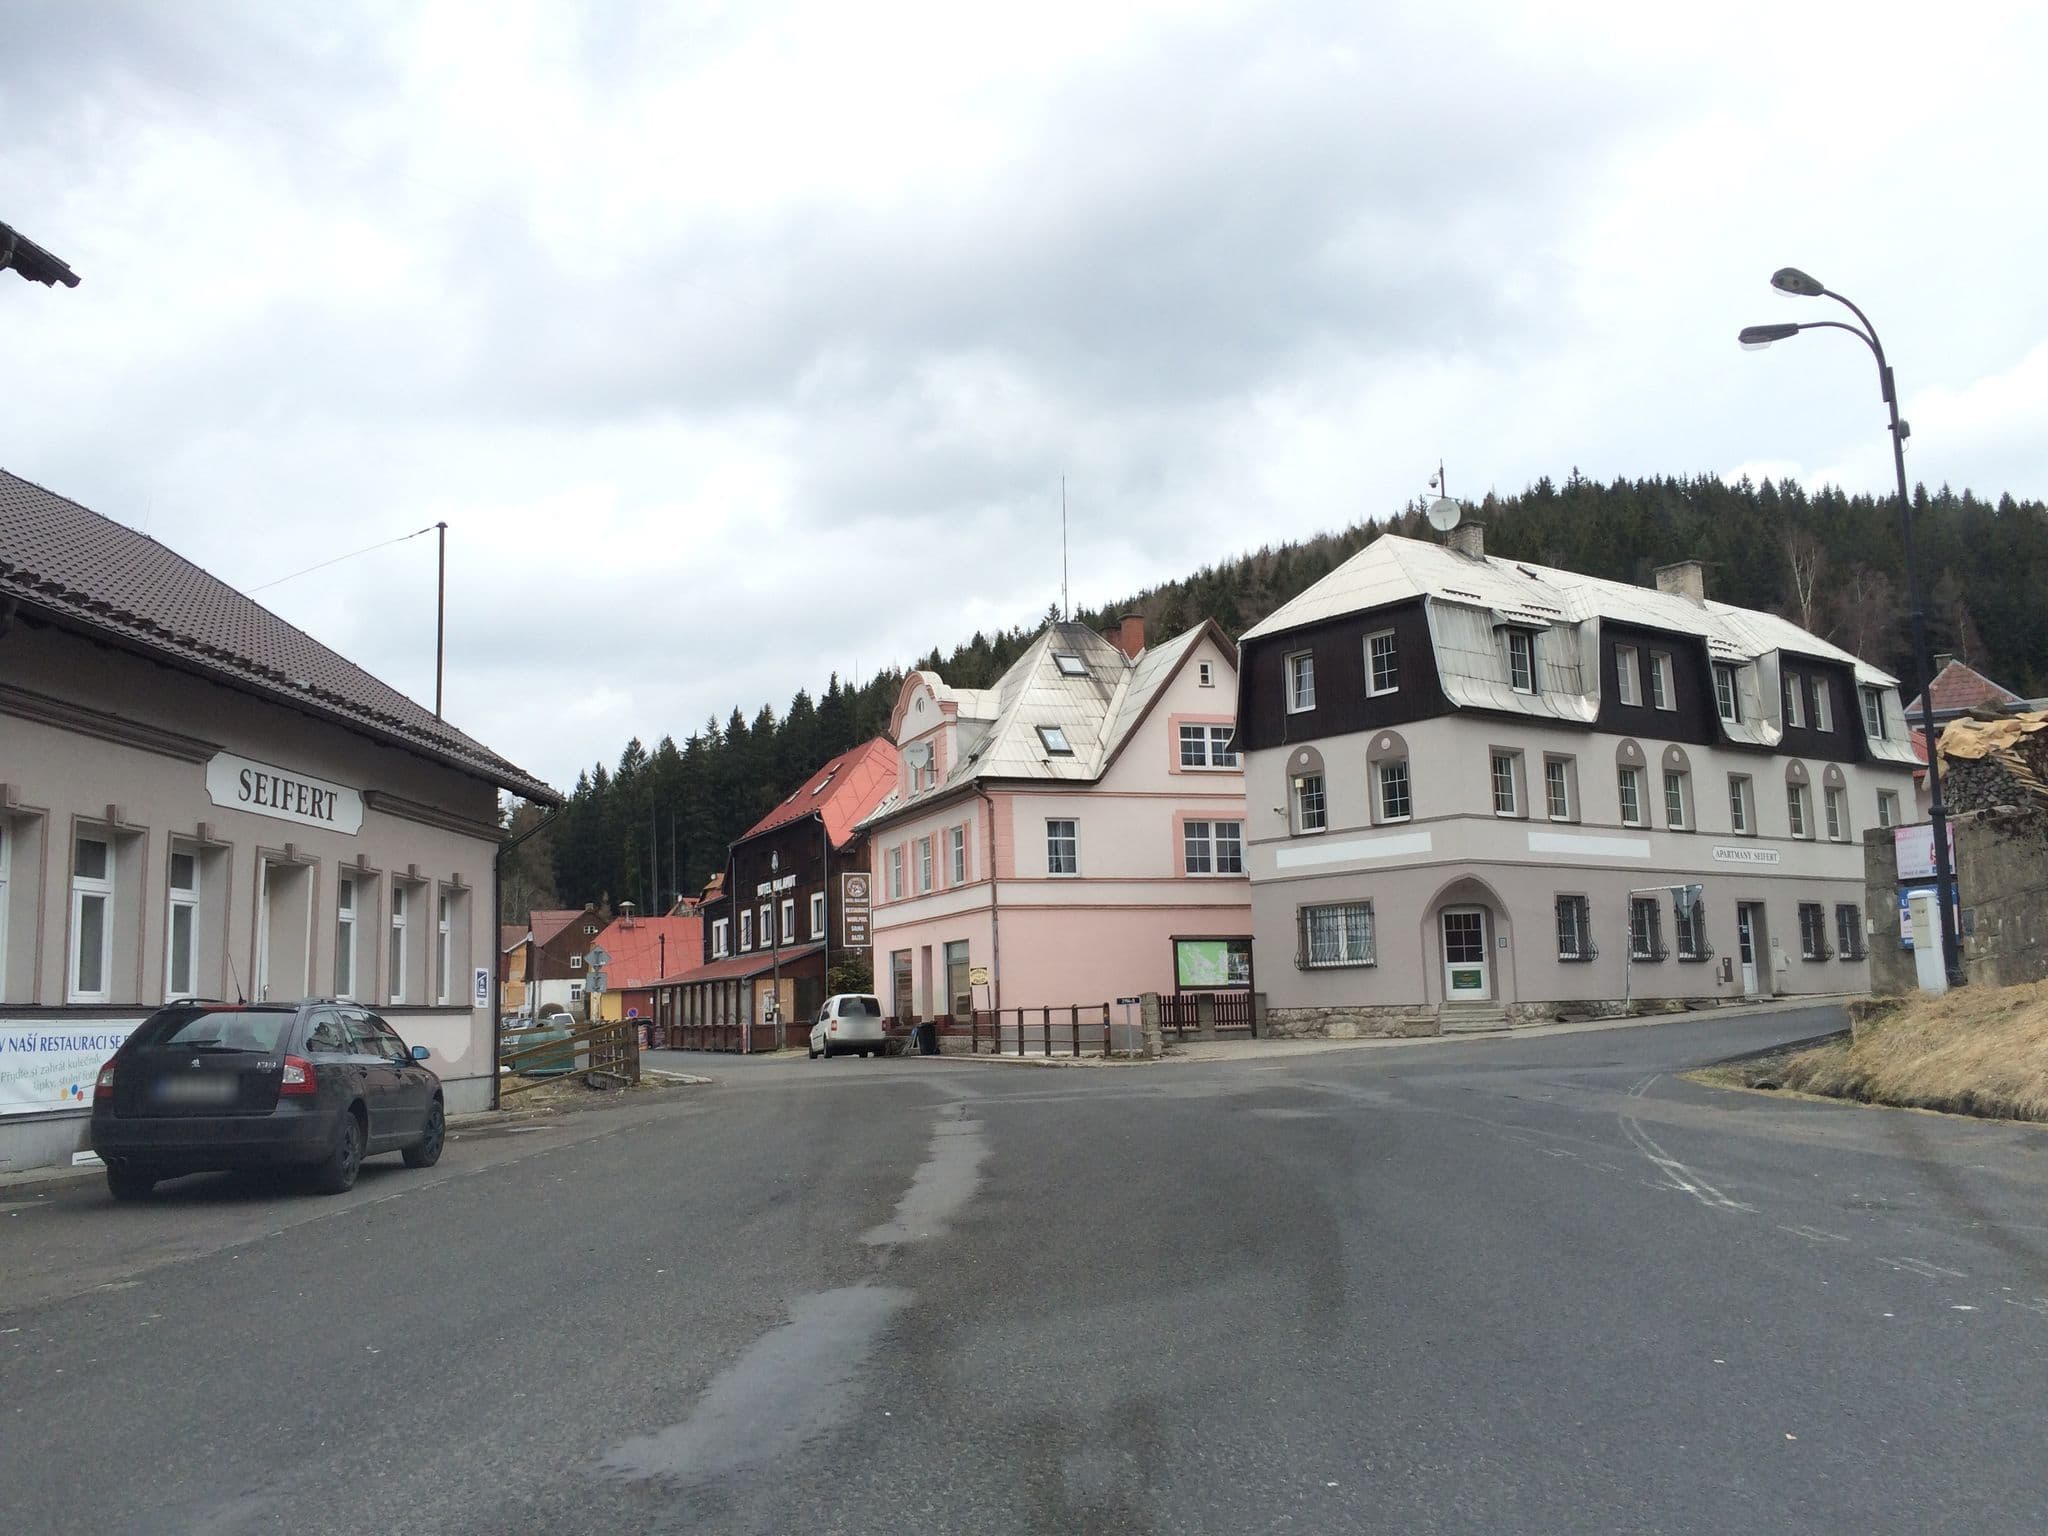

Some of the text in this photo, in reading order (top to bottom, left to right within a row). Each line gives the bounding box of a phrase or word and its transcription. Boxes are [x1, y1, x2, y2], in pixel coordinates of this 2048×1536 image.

[238, 768, 338, 822] SEIFERT
[1716, 849, 1777, 862] APARTMANY SEIFERT
[8, 1032, 38, 1053] NAŠÍ
[40, 1035, 107, 1052] RESTAURACI
[110, 1035, 121, 1049] SE
